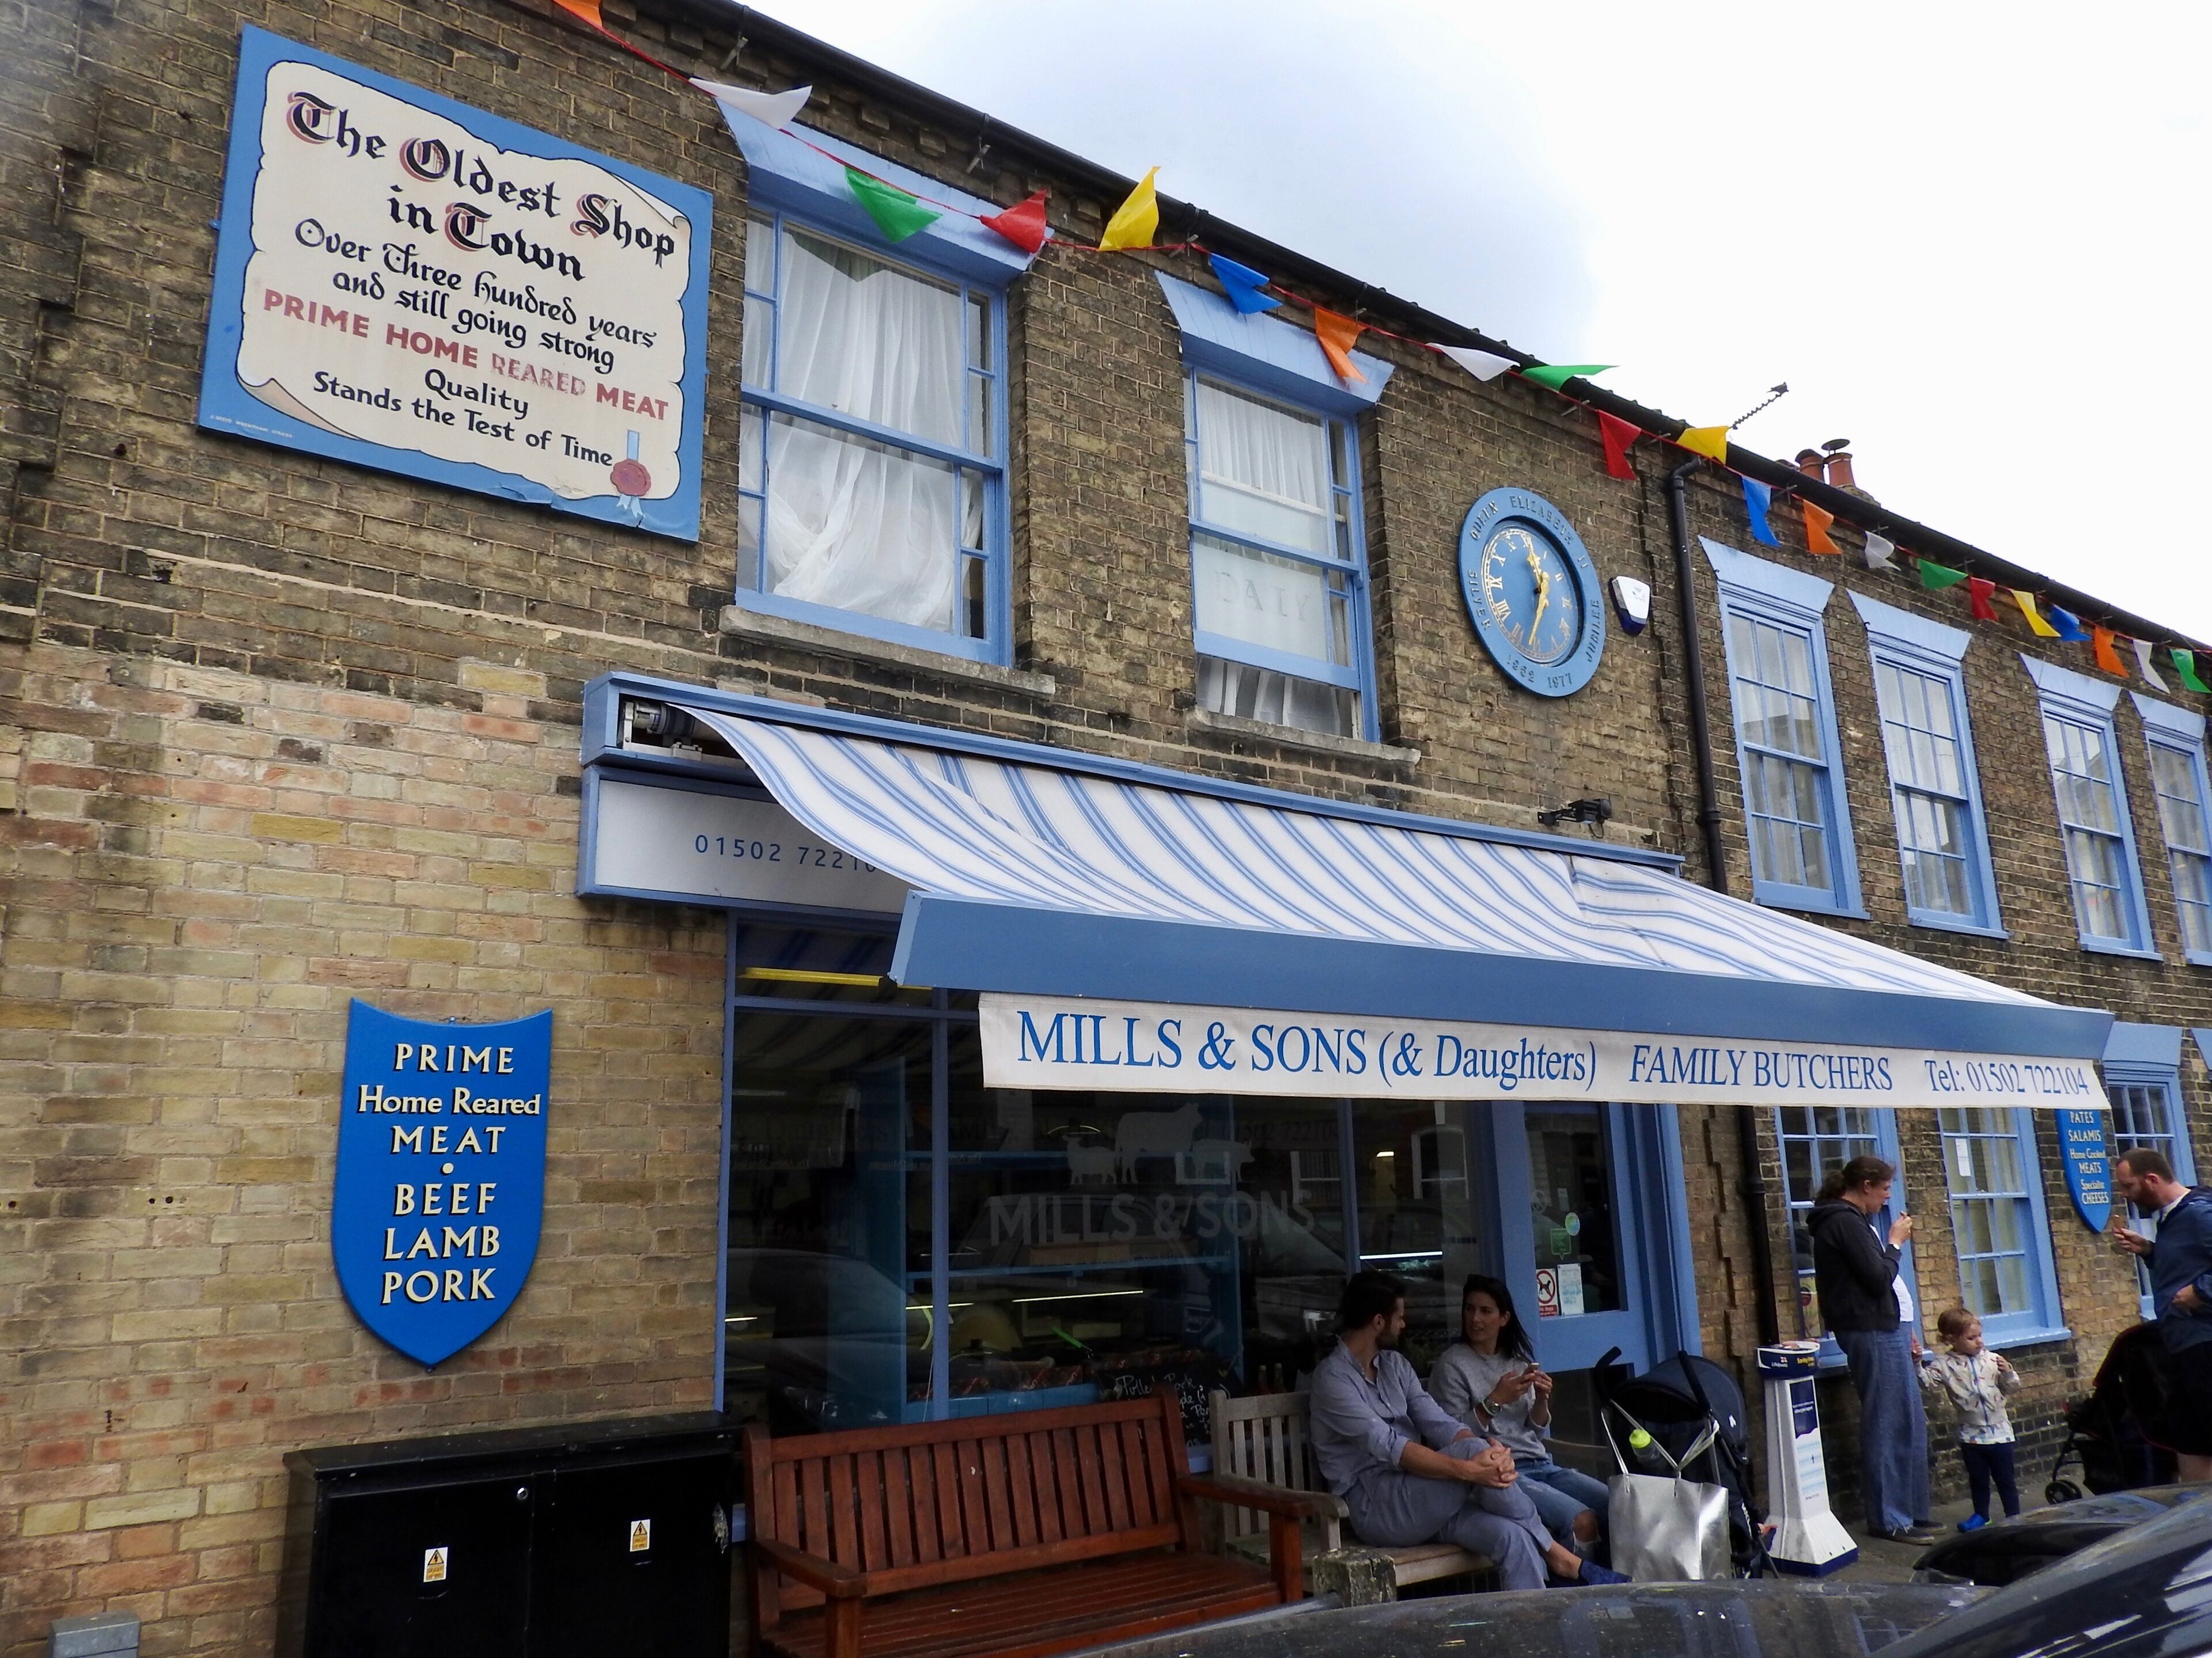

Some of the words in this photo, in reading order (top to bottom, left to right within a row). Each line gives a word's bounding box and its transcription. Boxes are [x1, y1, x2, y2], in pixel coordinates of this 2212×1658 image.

[286, 91, 387, 160] The
[399, 138, 561, 218] Oldest
[570, 194, 675, 269] Shop
[387, 184, 439, 234] in
[444, 202, 586, 281] Town
[295, 218, 372, 262] Over
[382, 243, 462, 290] Three
[586, 316, 657, 348] years
[332, 271, 385, 300] and
[394, 290, 450, 320] still
[452, 309, 527, 349] going
[537, 332, 614, 375] strong
[263, 288, 370, 338] PRIME
[386, 323, 478, 369] HOME
[491, 352, 586, 396] REARED
[596, 382, 669, 420] MEAT
[313, 371, 402, 412] Stands
[411, 398, 456, 426] the
[464, 408, 516, 441] Test
[525, 430, 552, 449] of
[560, 434, 613, 466] Time
[425, 369, 529, 420] Quality
[1509, 496, 1574, 545] ELIZABETH
[1468, 569, 1491, 631] SILVER
[1586, 599, 1600, 662] JUBILEE
[1547, 673, 1572, 688] 1977
[695, 834, 781, 862] 01502
[394, 1044, 514, 1073] PRIME
[1017, 1011, 1181, 1068] MILLS
[1199, 1021, 1236, 1070] &
[1252, 1024, 1366, 1075] SONS
[1378, 1031, 1423, 1087] (&
[1433, 1035, 1596, 1091] Daughters)
[1628, 1045, 1747, 1086] FAMILY
[1753, 1051, 1892, 1091] BUTCHERS
[1925, 1060, 1964, 1092] Tel:
[1966, 1061, 2025, 1093] 01502
[2024, 1065, 2089, 1095] 722104
[358, 1084, 442, 1114] Home
[452, 1087, 541, 1115] Reared
[391, 1125, 506, 1153] MEAT
[2068, 1129, 2102, 1142] SALAMIS
[2078, 1162, 2101, 1174] MEATS
[394, 1182, 497, 1215] BEEF
[990, 1193, 1137, 1246] MILLS
[1153, 1193, 1183, 1240] &
[1196, 1189, 1315, 1238] SONS
[2082, 1192, 2109, 1204] CHEESES
[384, 1226, 501, 1259] LAMB
[381, 1268, 497, 1304] PORK
